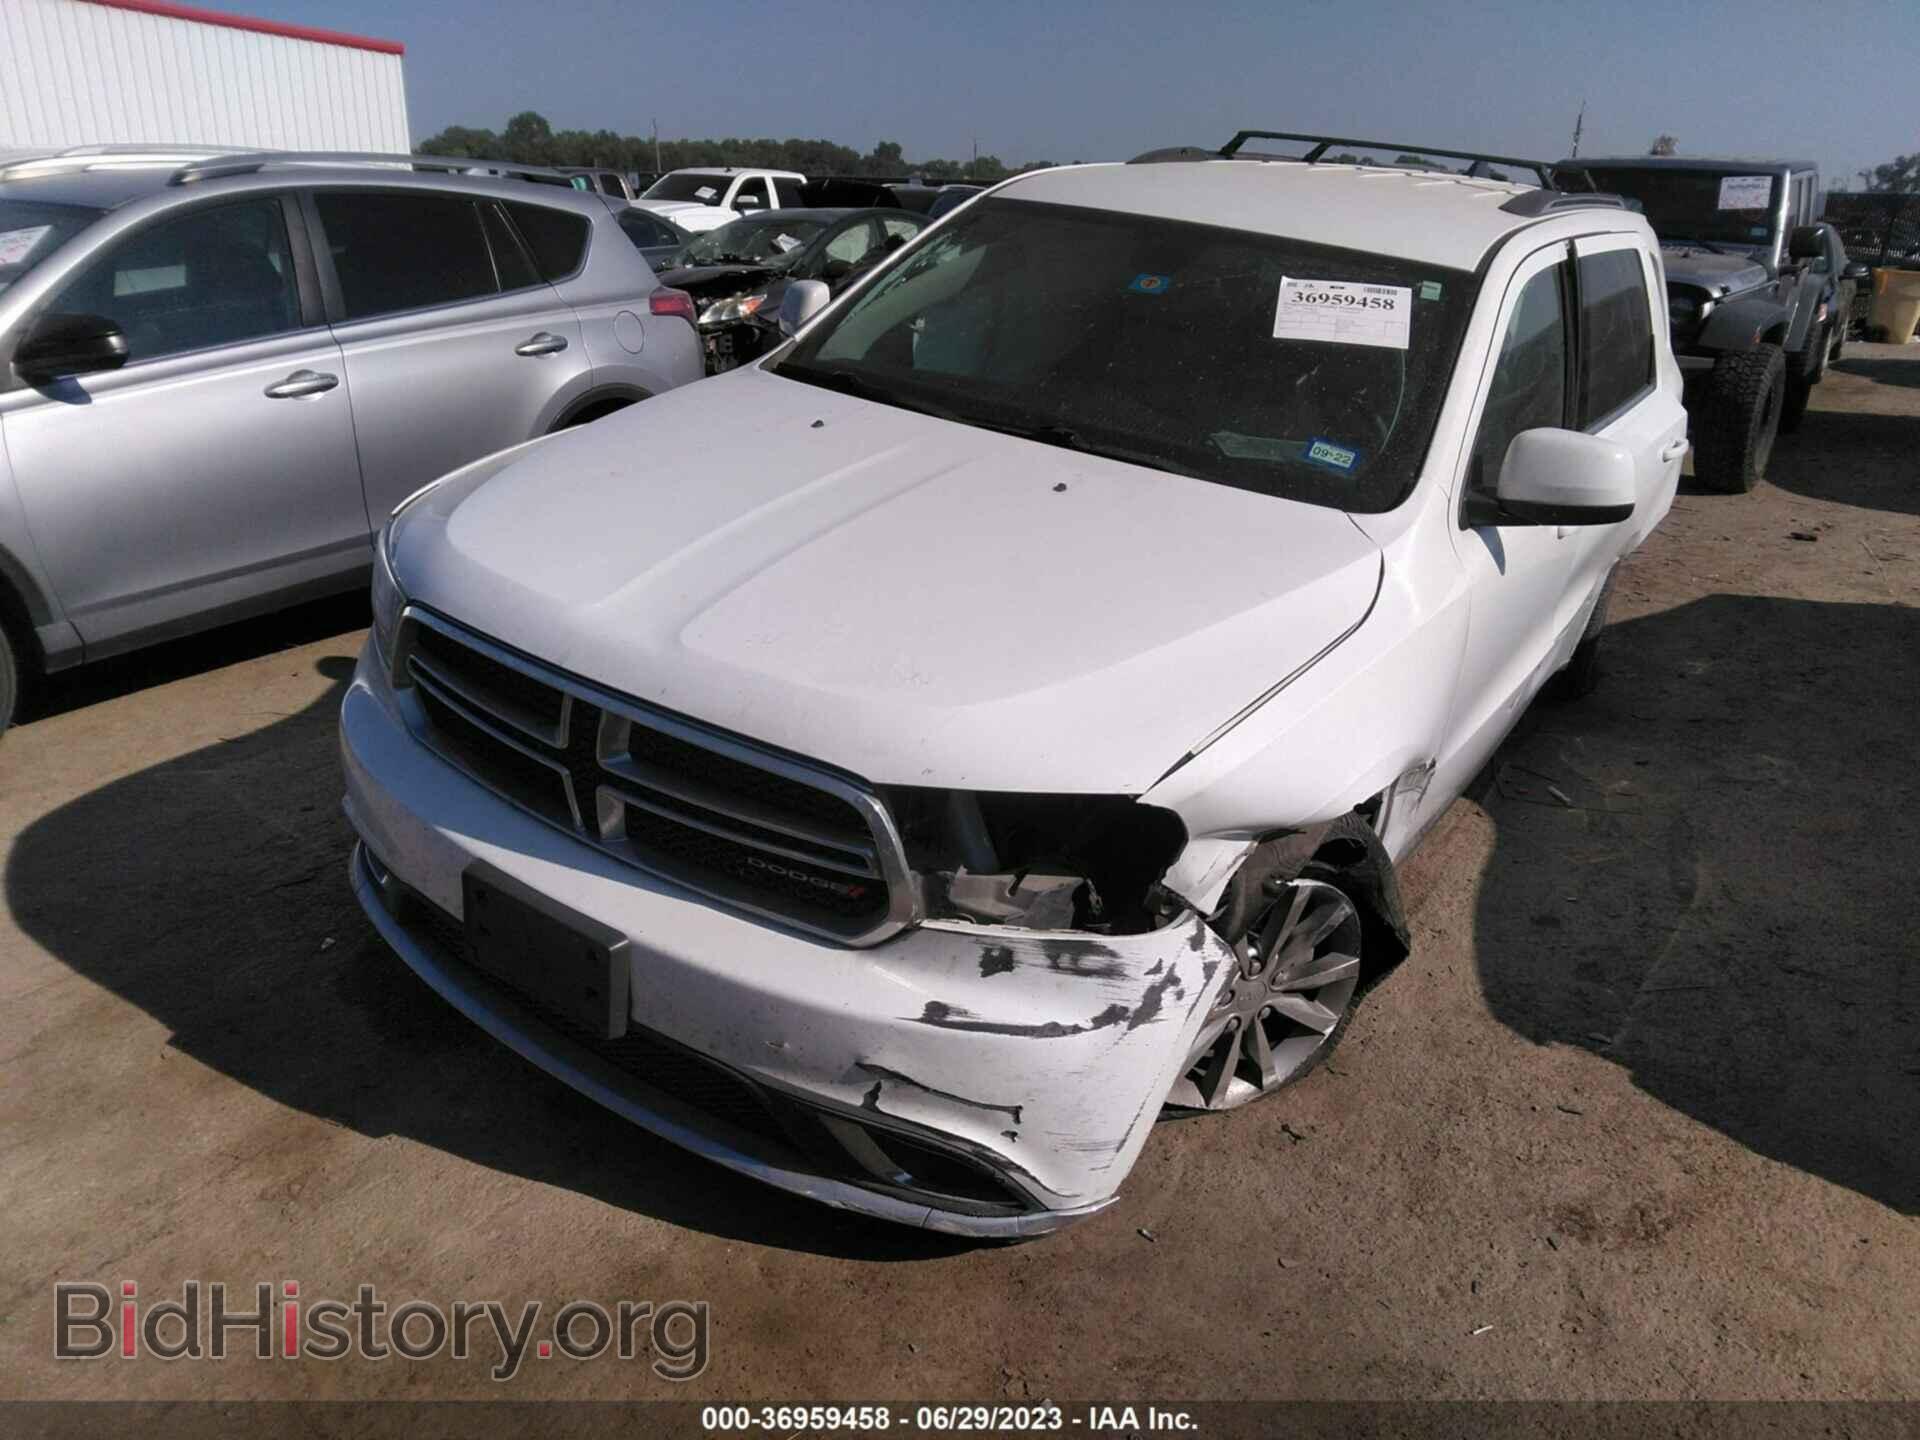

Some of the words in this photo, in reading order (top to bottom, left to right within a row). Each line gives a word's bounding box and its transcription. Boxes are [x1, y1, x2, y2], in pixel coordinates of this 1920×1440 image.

[1291, 291, 1395, 311] 36959458
[1313, 446, 1351, 464] 09-22
[747, 857, 849, 894] DODGE
